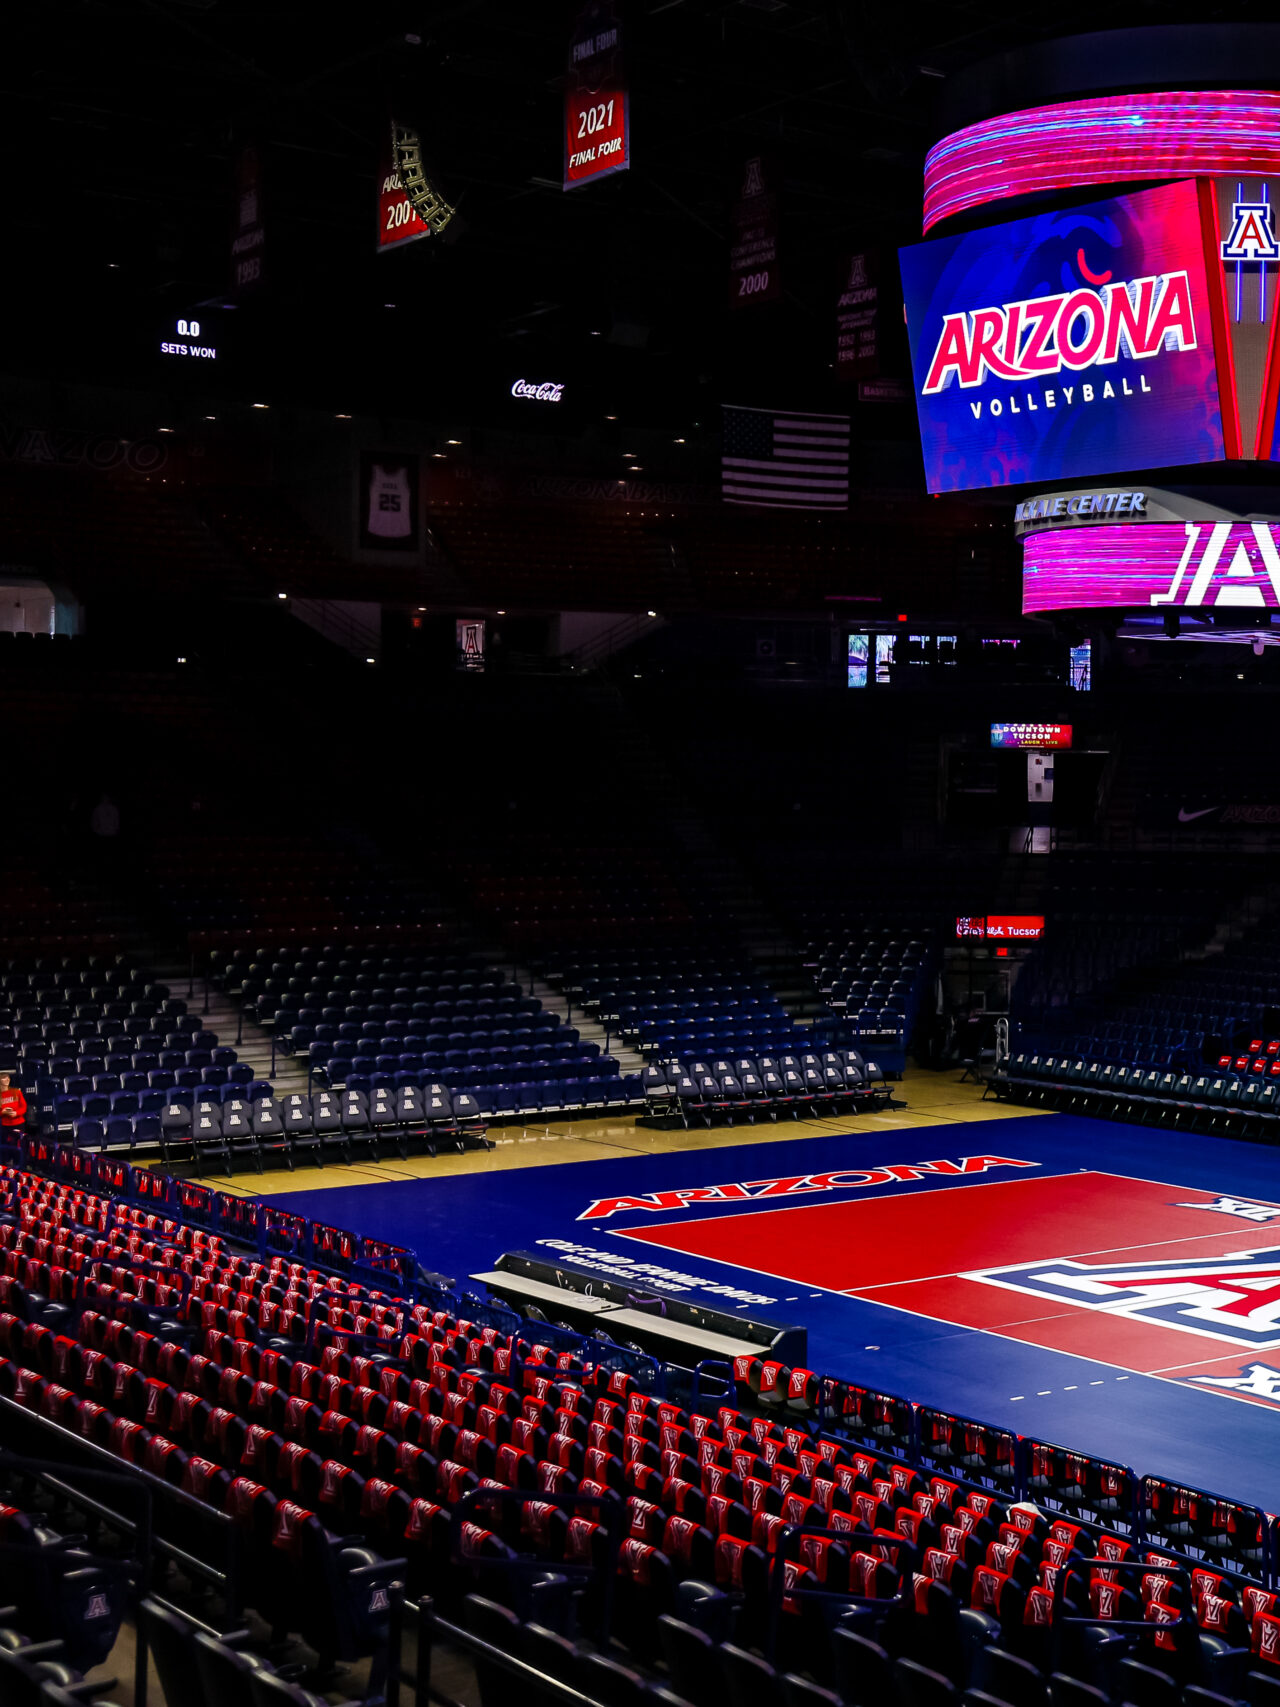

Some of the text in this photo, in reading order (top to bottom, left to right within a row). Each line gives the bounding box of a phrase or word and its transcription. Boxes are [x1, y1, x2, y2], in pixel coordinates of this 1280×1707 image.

[578, 99, 614, 139] 2021
[569, 137, 621, 168] FINAL FOUR
[1220, 203, 1280, 260] A
[739, 272, 769, 296] 2000
[177, 319, 200, 337] 0.0
[922, 270, 1197, 395] ARIZONA
[161, 342, 216, 359] SETS WON
[511, 379, 564, 402] Coca-Cola
[971, 375, 1151, 419] VOLLEYBALL
[379, 493, 401, 512] 25
[1014, 492, 1145, 522] MCKALE CENTER
[575, 1154, 1043, 1221] ARIZONA
[577, 1252, 635, 1268] AND
[701, 1285, 779, 1304] DAVIS
[638, 1276, 691, 1292] COURT
